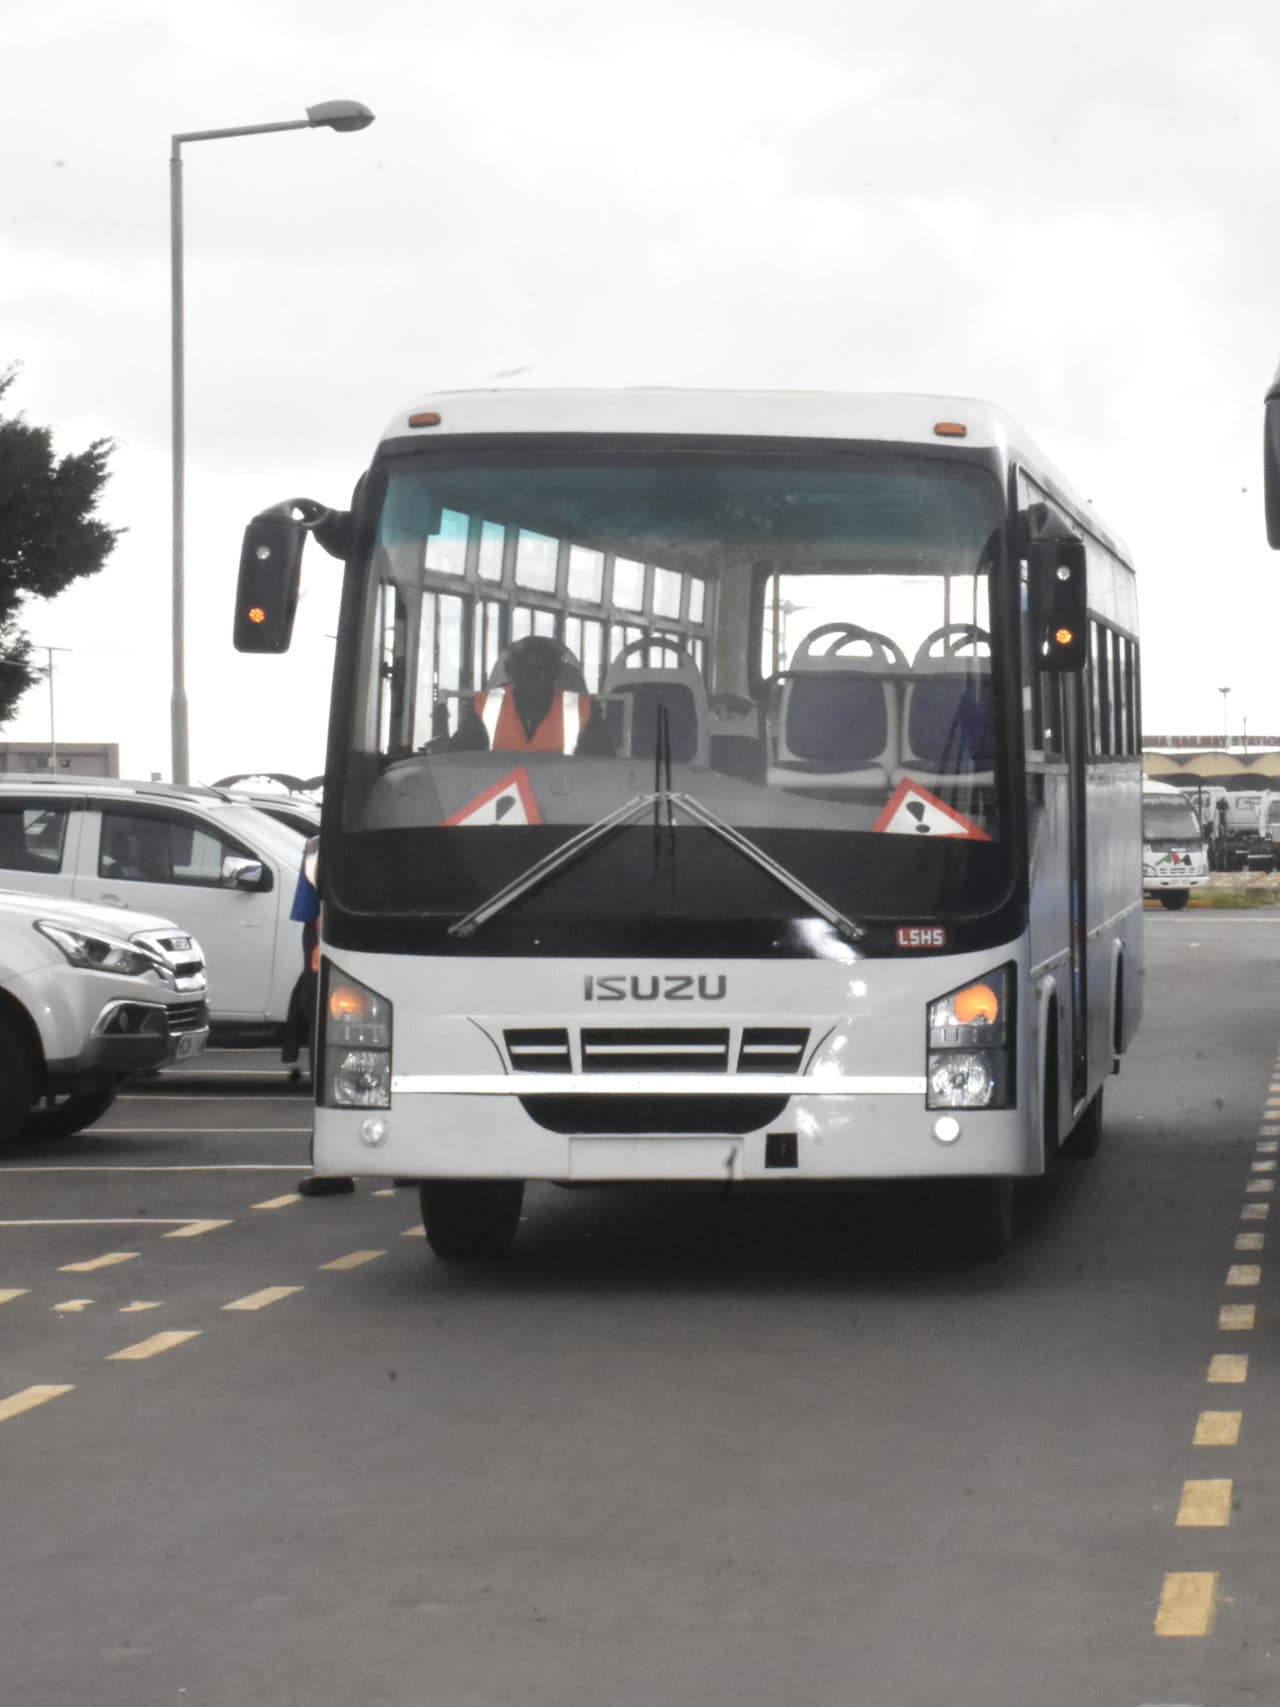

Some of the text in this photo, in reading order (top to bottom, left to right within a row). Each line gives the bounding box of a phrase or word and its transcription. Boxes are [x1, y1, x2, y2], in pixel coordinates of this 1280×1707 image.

[1171, 735, 1228, 748] RAILWAY
[899, 929, 943, 945] LSHS
[584, 975, 726, 1000] ISUZU
